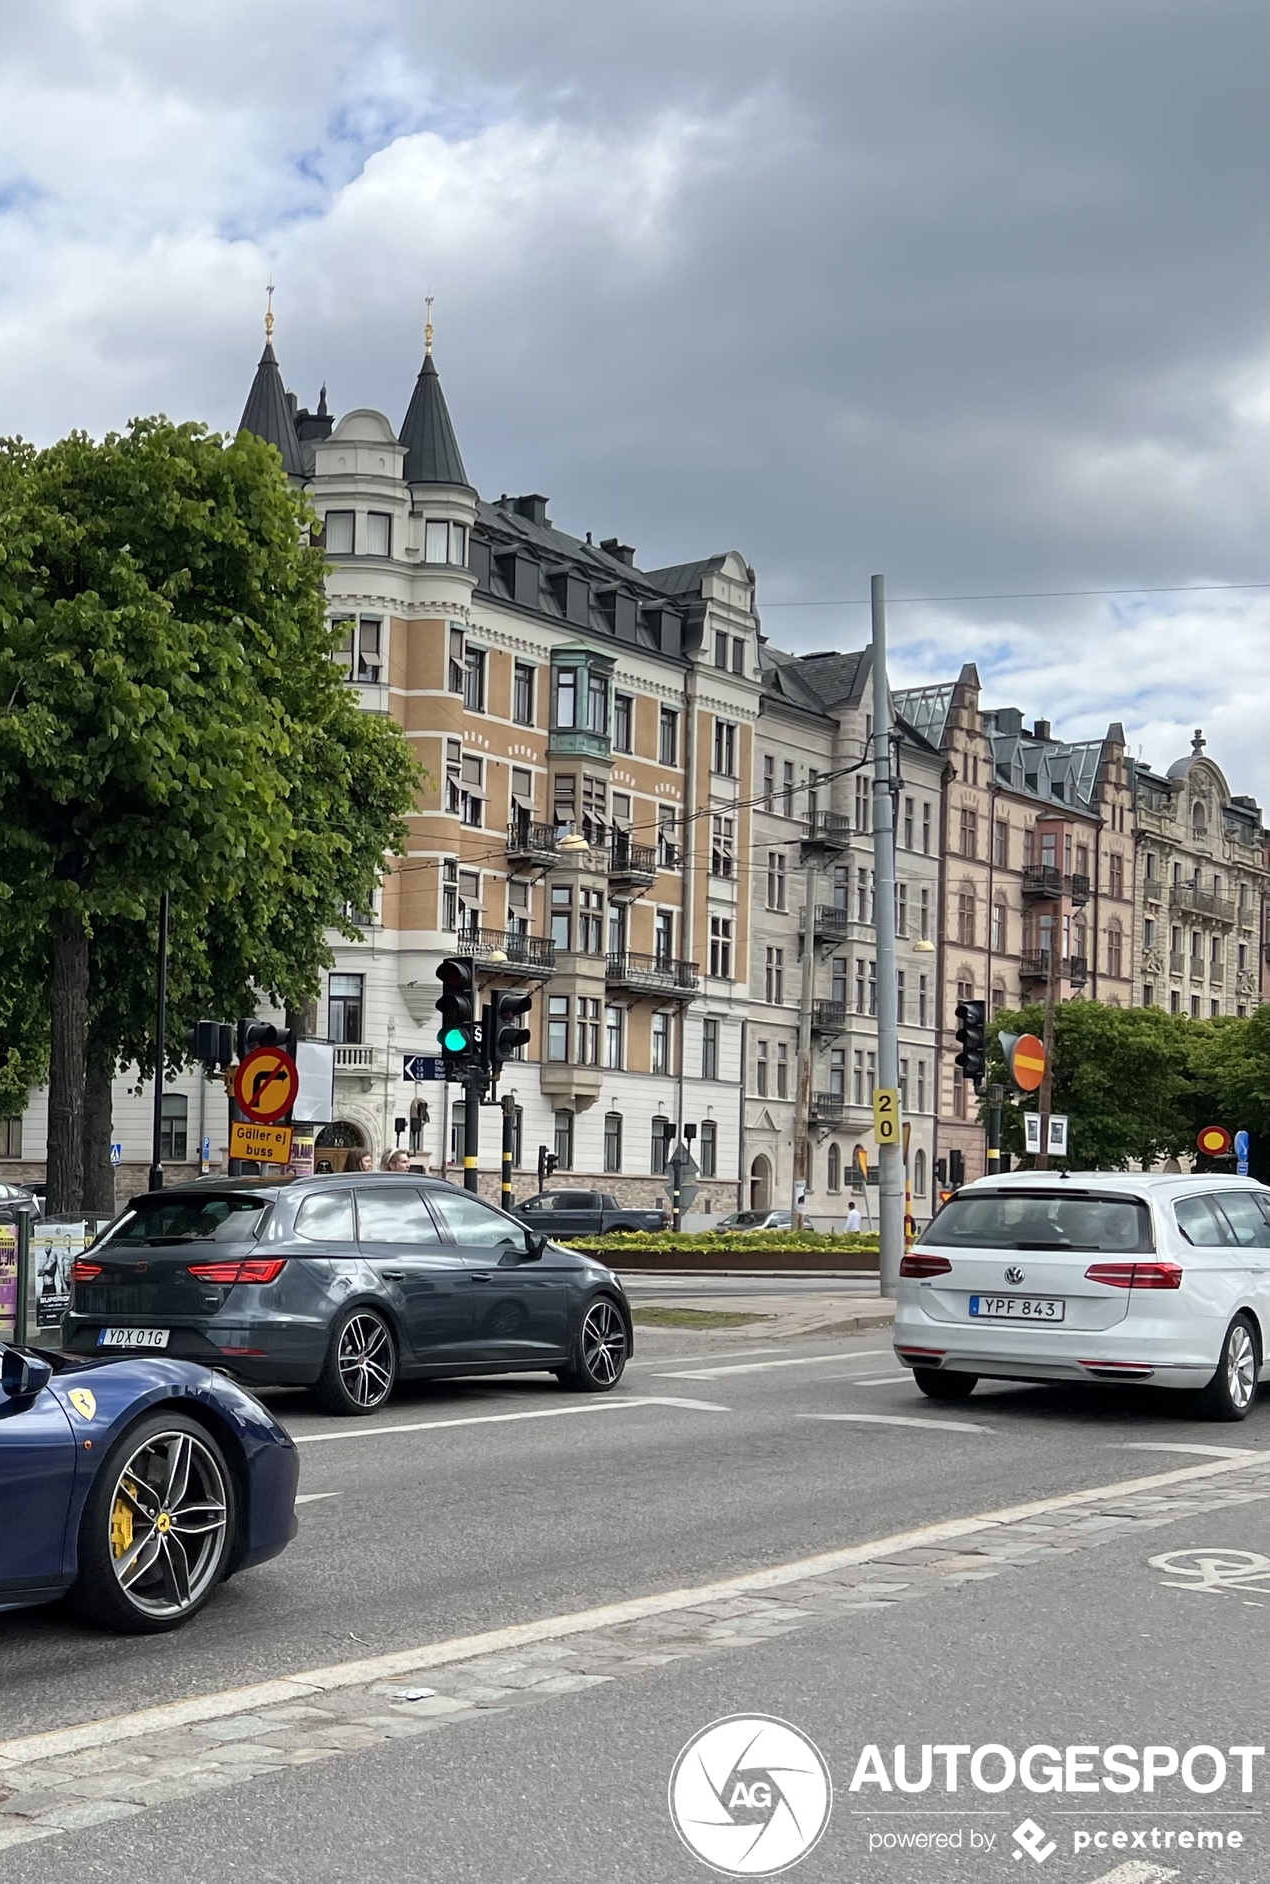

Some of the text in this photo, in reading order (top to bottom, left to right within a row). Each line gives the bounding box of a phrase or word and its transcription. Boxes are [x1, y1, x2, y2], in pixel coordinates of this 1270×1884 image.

[237, 1127, 286, 1145] Gäller ej
[246, 1144, 273, 1157] buss
[40, 1295, 70, 1303] SUPERIO
[985, 1299, 1055, 1316] YPF 843
[110, 1330, 134, 1344] YDX
